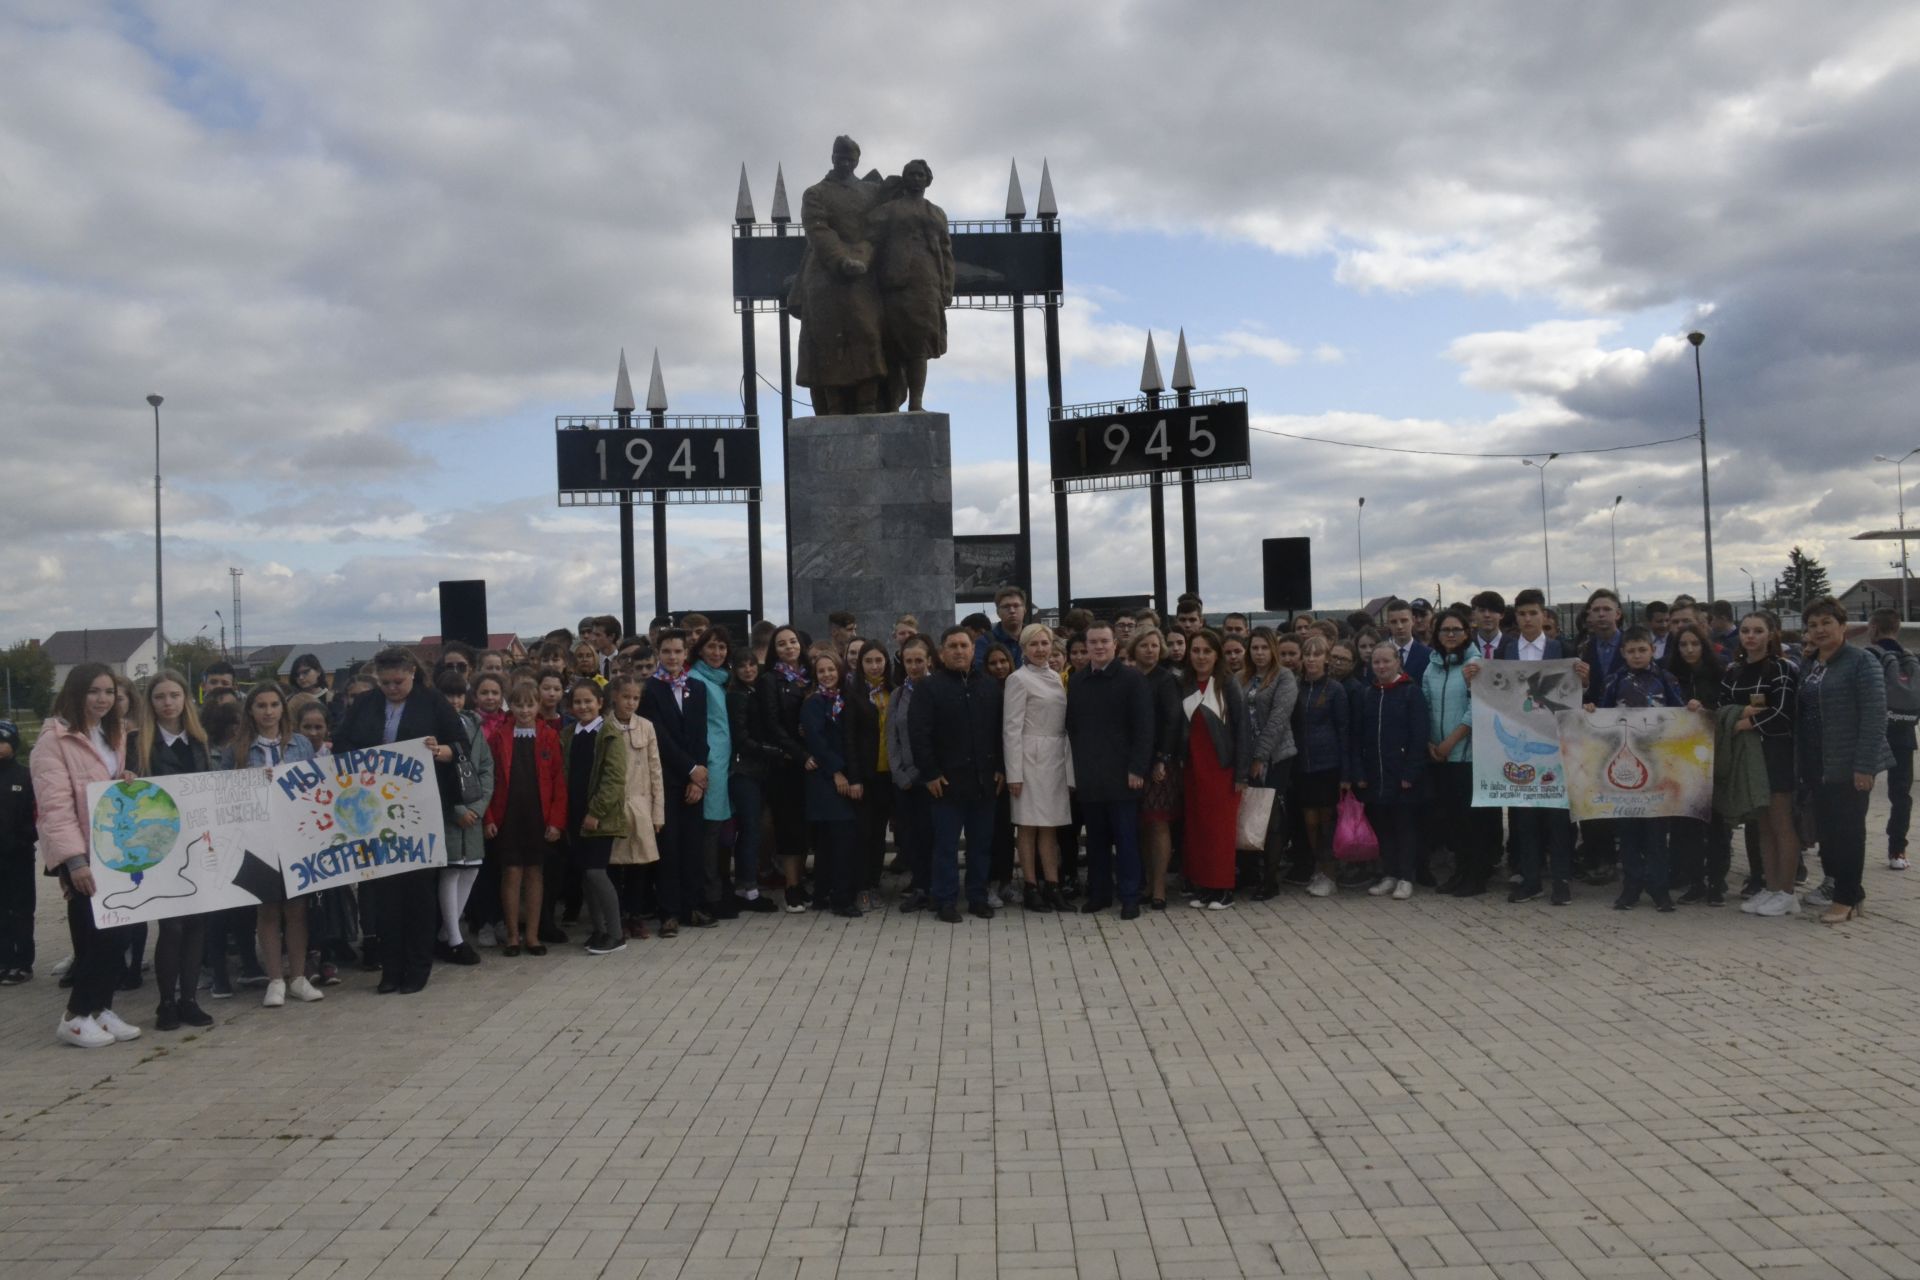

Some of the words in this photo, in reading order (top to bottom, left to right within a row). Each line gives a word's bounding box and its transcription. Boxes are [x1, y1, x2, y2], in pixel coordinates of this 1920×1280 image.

[595, 438, 726, 480] 1941
[1076, 415, 1217, 468] 1945
[1886, 710, 1918, 721] Suprem
[277, 759, 326, 801] МЫ
[333, 749, 424, 783] ПРОТИВ
[289, 832, 436, 891] ЭКСТРЕМИЗМА!
